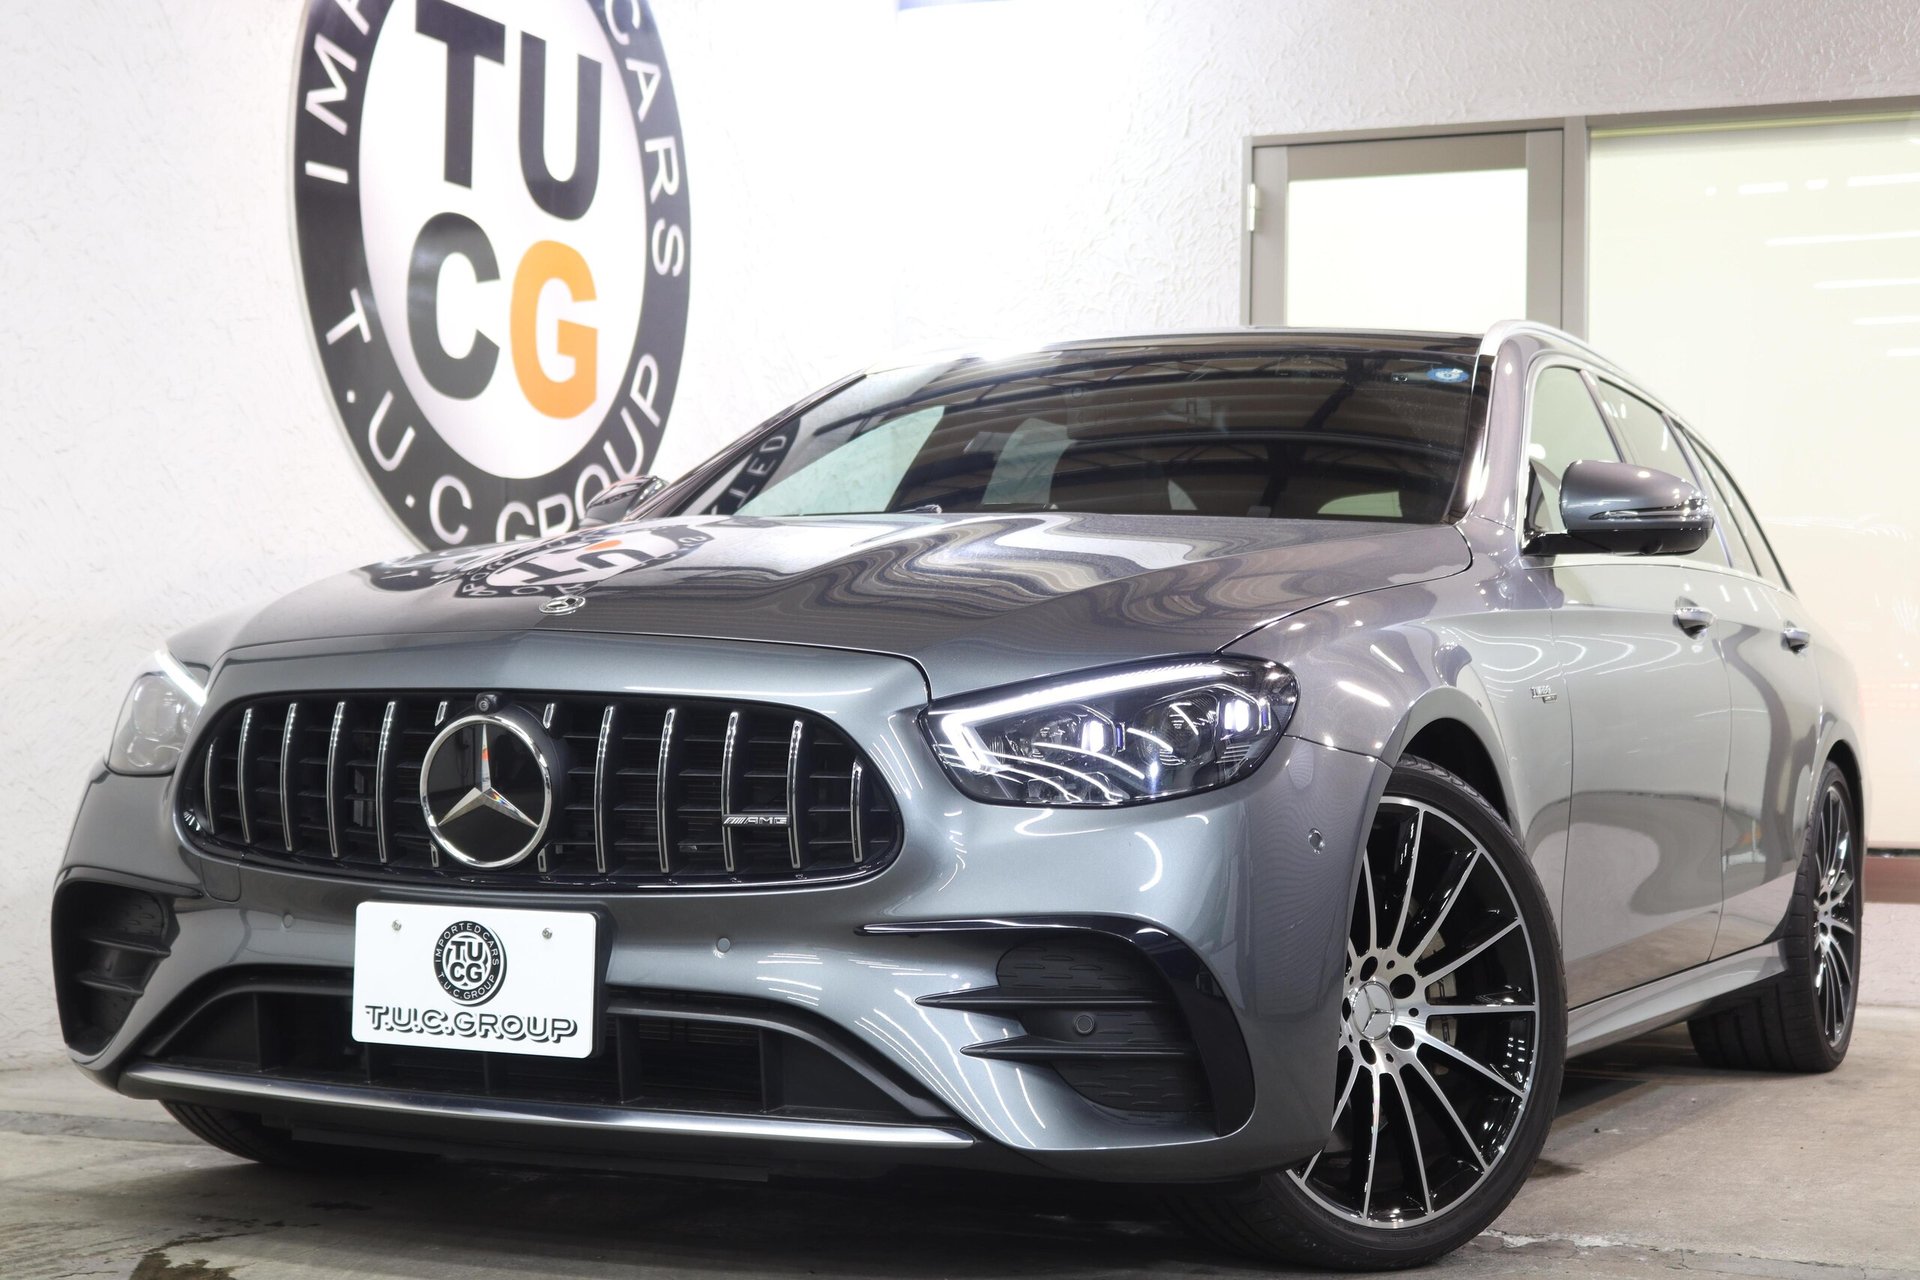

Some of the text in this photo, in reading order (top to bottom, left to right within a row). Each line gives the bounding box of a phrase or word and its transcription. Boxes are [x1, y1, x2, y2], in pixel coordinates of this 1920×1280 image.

[415, 0, 603, 222] TU
[605, 0, 684, 278] CARS
[407, 212, 598, 420] CG
[434, 923, 500, 966] IMPORTED CARS
[449, 961, 483, 983] CG
[450, 940, 483, 961] TU
